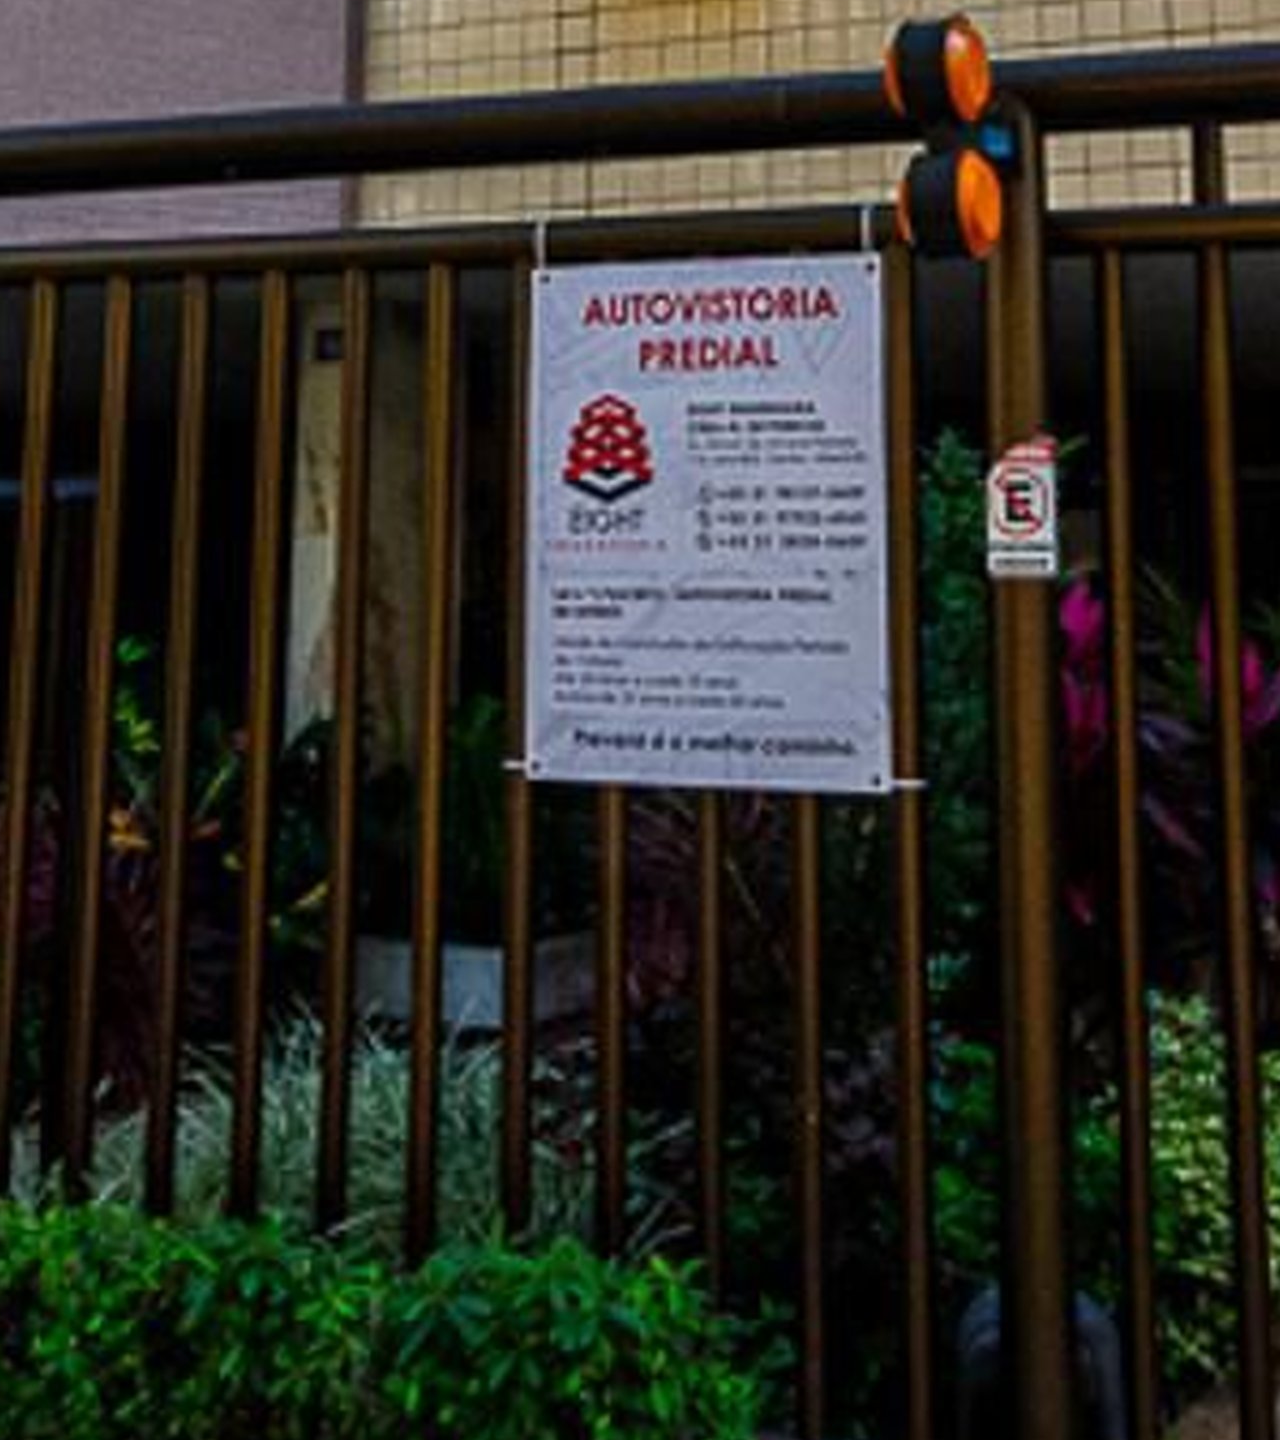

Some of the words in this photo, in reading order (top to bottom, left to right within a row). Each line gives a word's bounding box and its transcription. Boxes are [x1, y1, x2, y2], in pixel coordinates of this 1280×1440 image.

[582, 285, 840, 327] AUTOVISTORIA
[637, 335, 779, 372] PREDIAL
[567, 507, 644, 536] EIGHT
